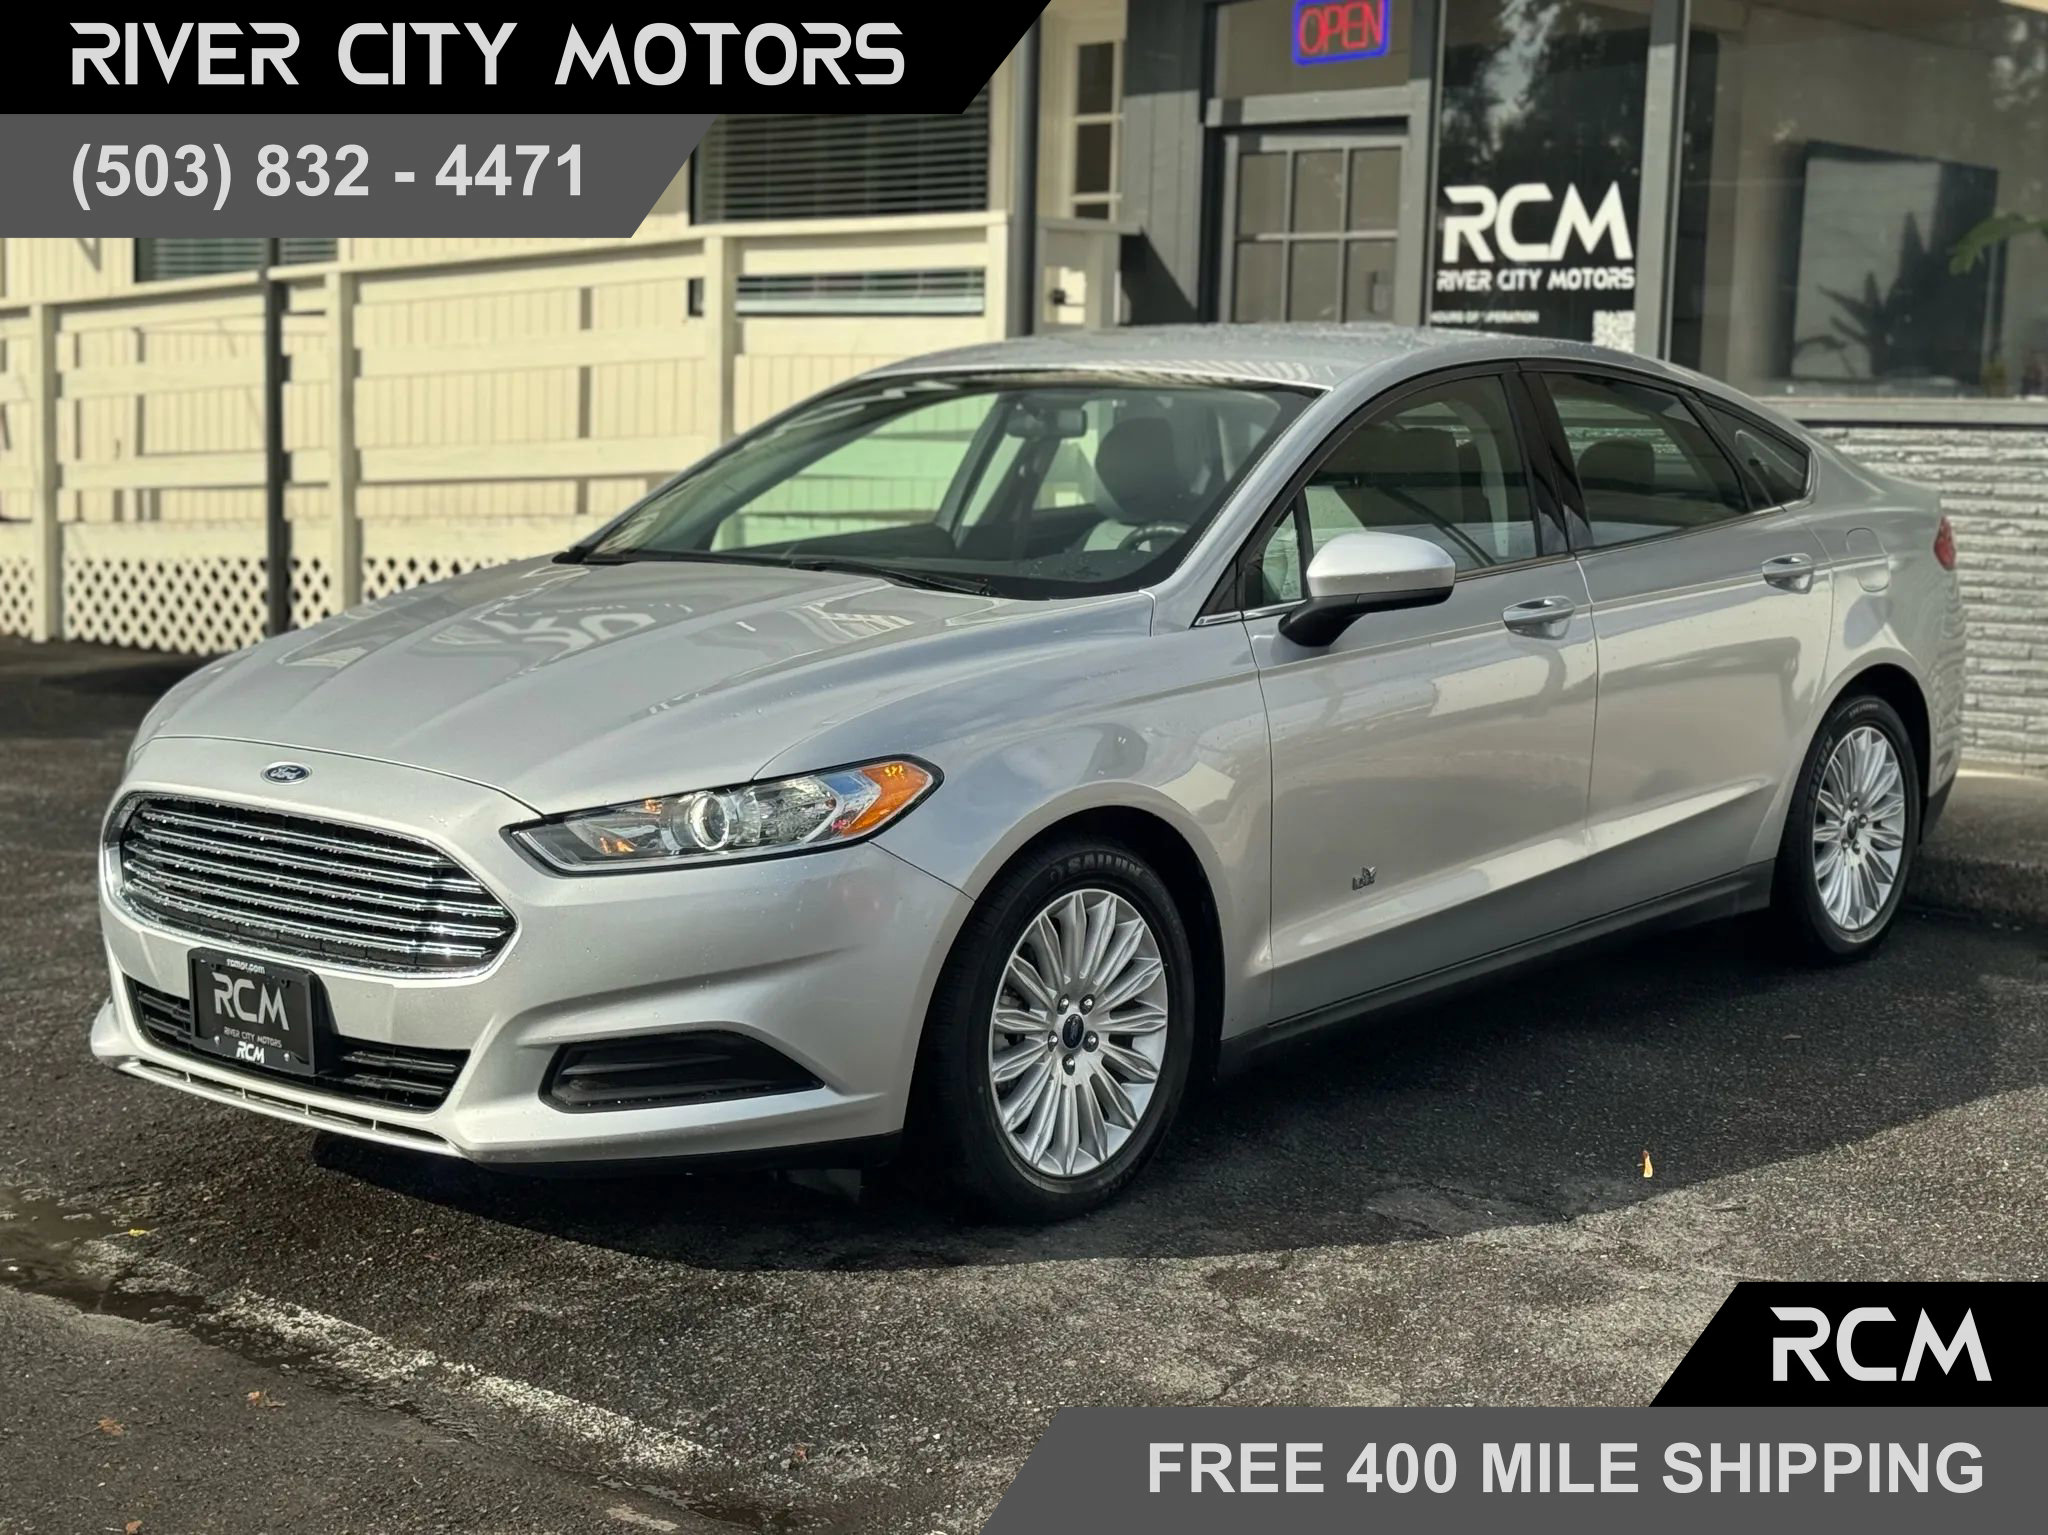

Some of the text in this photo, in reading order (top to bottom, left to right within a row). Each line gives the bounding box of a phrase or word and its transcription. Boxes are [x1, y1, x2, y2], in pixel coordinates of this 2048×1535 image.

[1298, 0, 1384, 56] OPEN
[1443, 181, 1634, 263] RCM
[1436, 266, 1636, 292] RIVER CITY MOTORS
[211, 971, 290, 1032] RCM
[223, 1025, 283, 1049] RIVER CITY MOTORS
[236, 1040, 265, 1064] RCM
